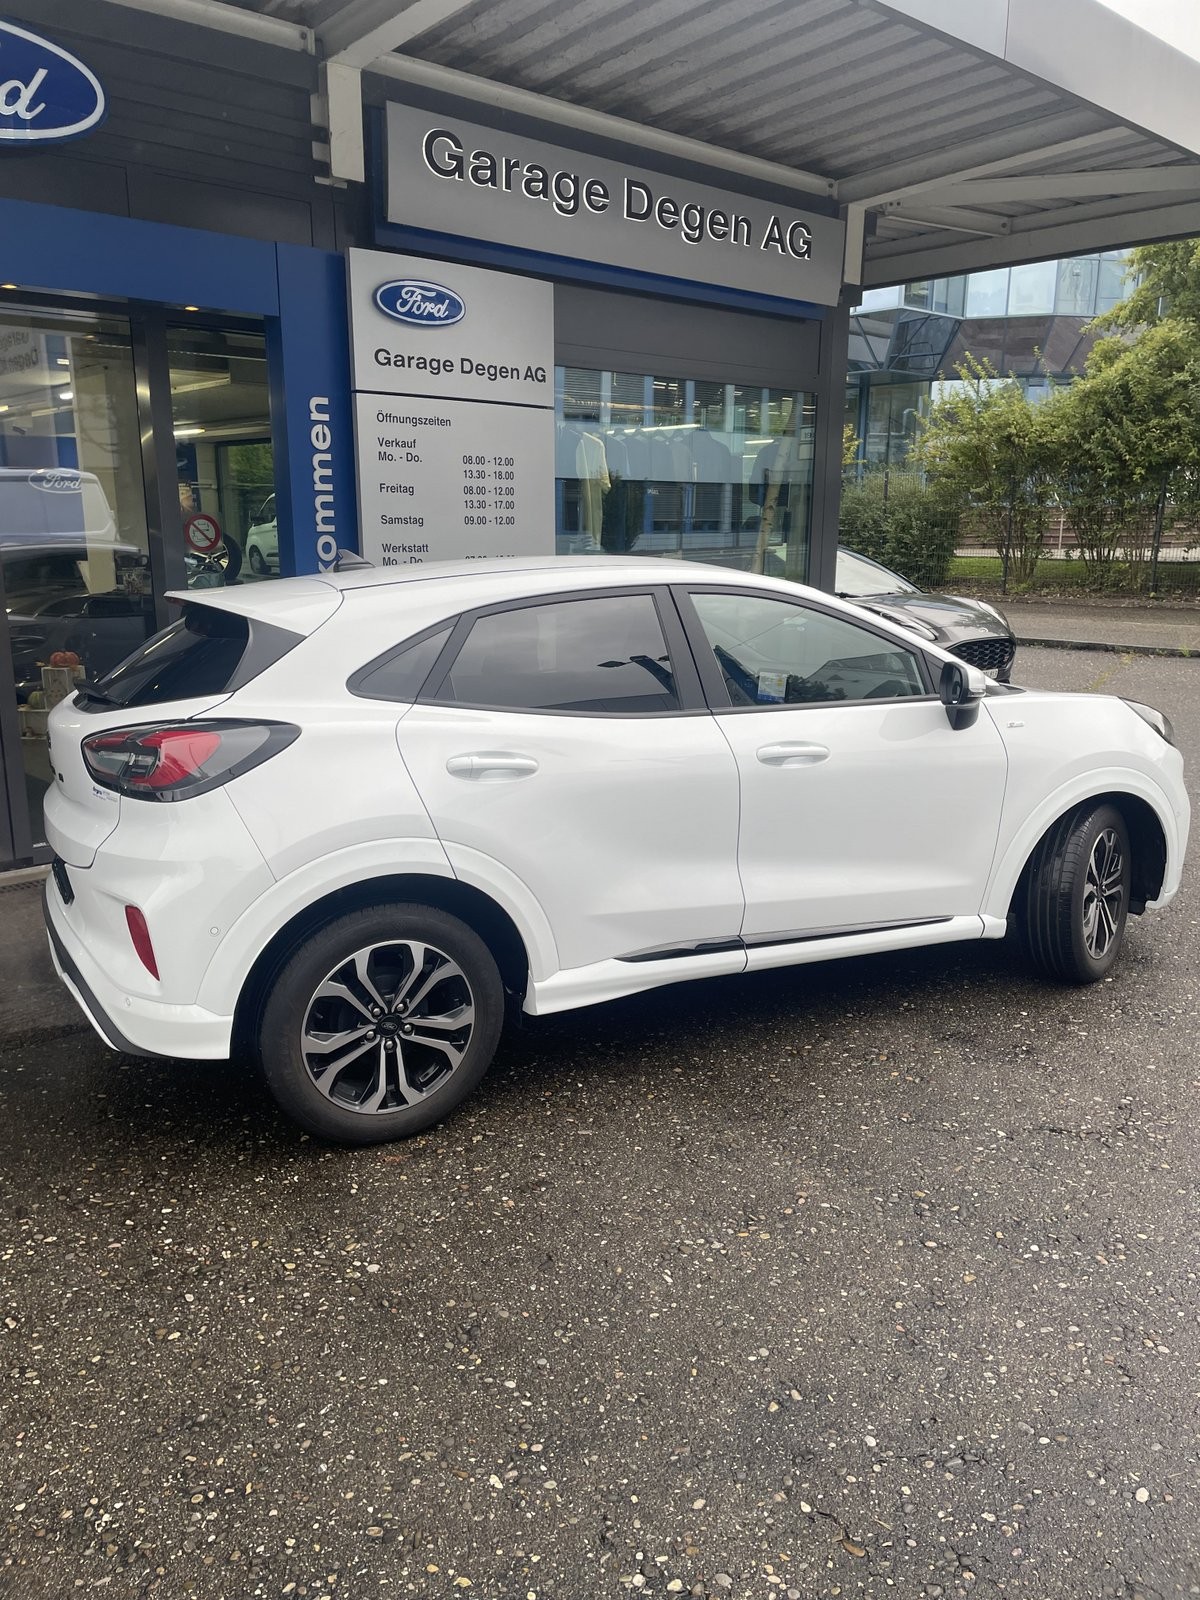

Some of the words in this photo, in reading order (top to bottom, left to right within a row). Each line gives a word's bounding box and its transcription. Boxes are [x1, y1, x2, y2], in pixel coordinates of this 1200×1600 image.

[422, 128, 610, 217] Garage
[623, 178, 753, 245] Degen
[760, 216, 813, 261] AG
[396, 286, 449, 318] Ford
[374, 348, 454, 375] Garage
[460, 357, 520, 381] Degen
[523, 366, 546, 383] AG
[376, 409, 452, 427] Öffnungszeiten
[377, 437, 417, 449] Verkauf
[378, 451, 397, 462] Mo.
[406, 452, 423, 463] Do.
[462, 455, 486, 466] 08.00
[493, 456, 515, 467] 12.00
[42, 471, 82, 489] Ford
[463, 469, 486, 480] 13.30
[493, 470, 515, 481] 18.00
[379, 483, 415, 496] Freitag
[463, 485, 487, 496] 08.00
[493, 486, 515, 496] 12.00
[464, 499, 487, 509] 13.30
[493, 500, 515, 510] 17.00
[380, 514, 424, 527] Samstag
[464, 515, 487, 525] 09.00
[494, 516, 515, 525] 12.00
[381, 543, 429, 553] Werkstatt
[382, 556, 398, 567] Mo
[409, 556, 425, 565] Do
